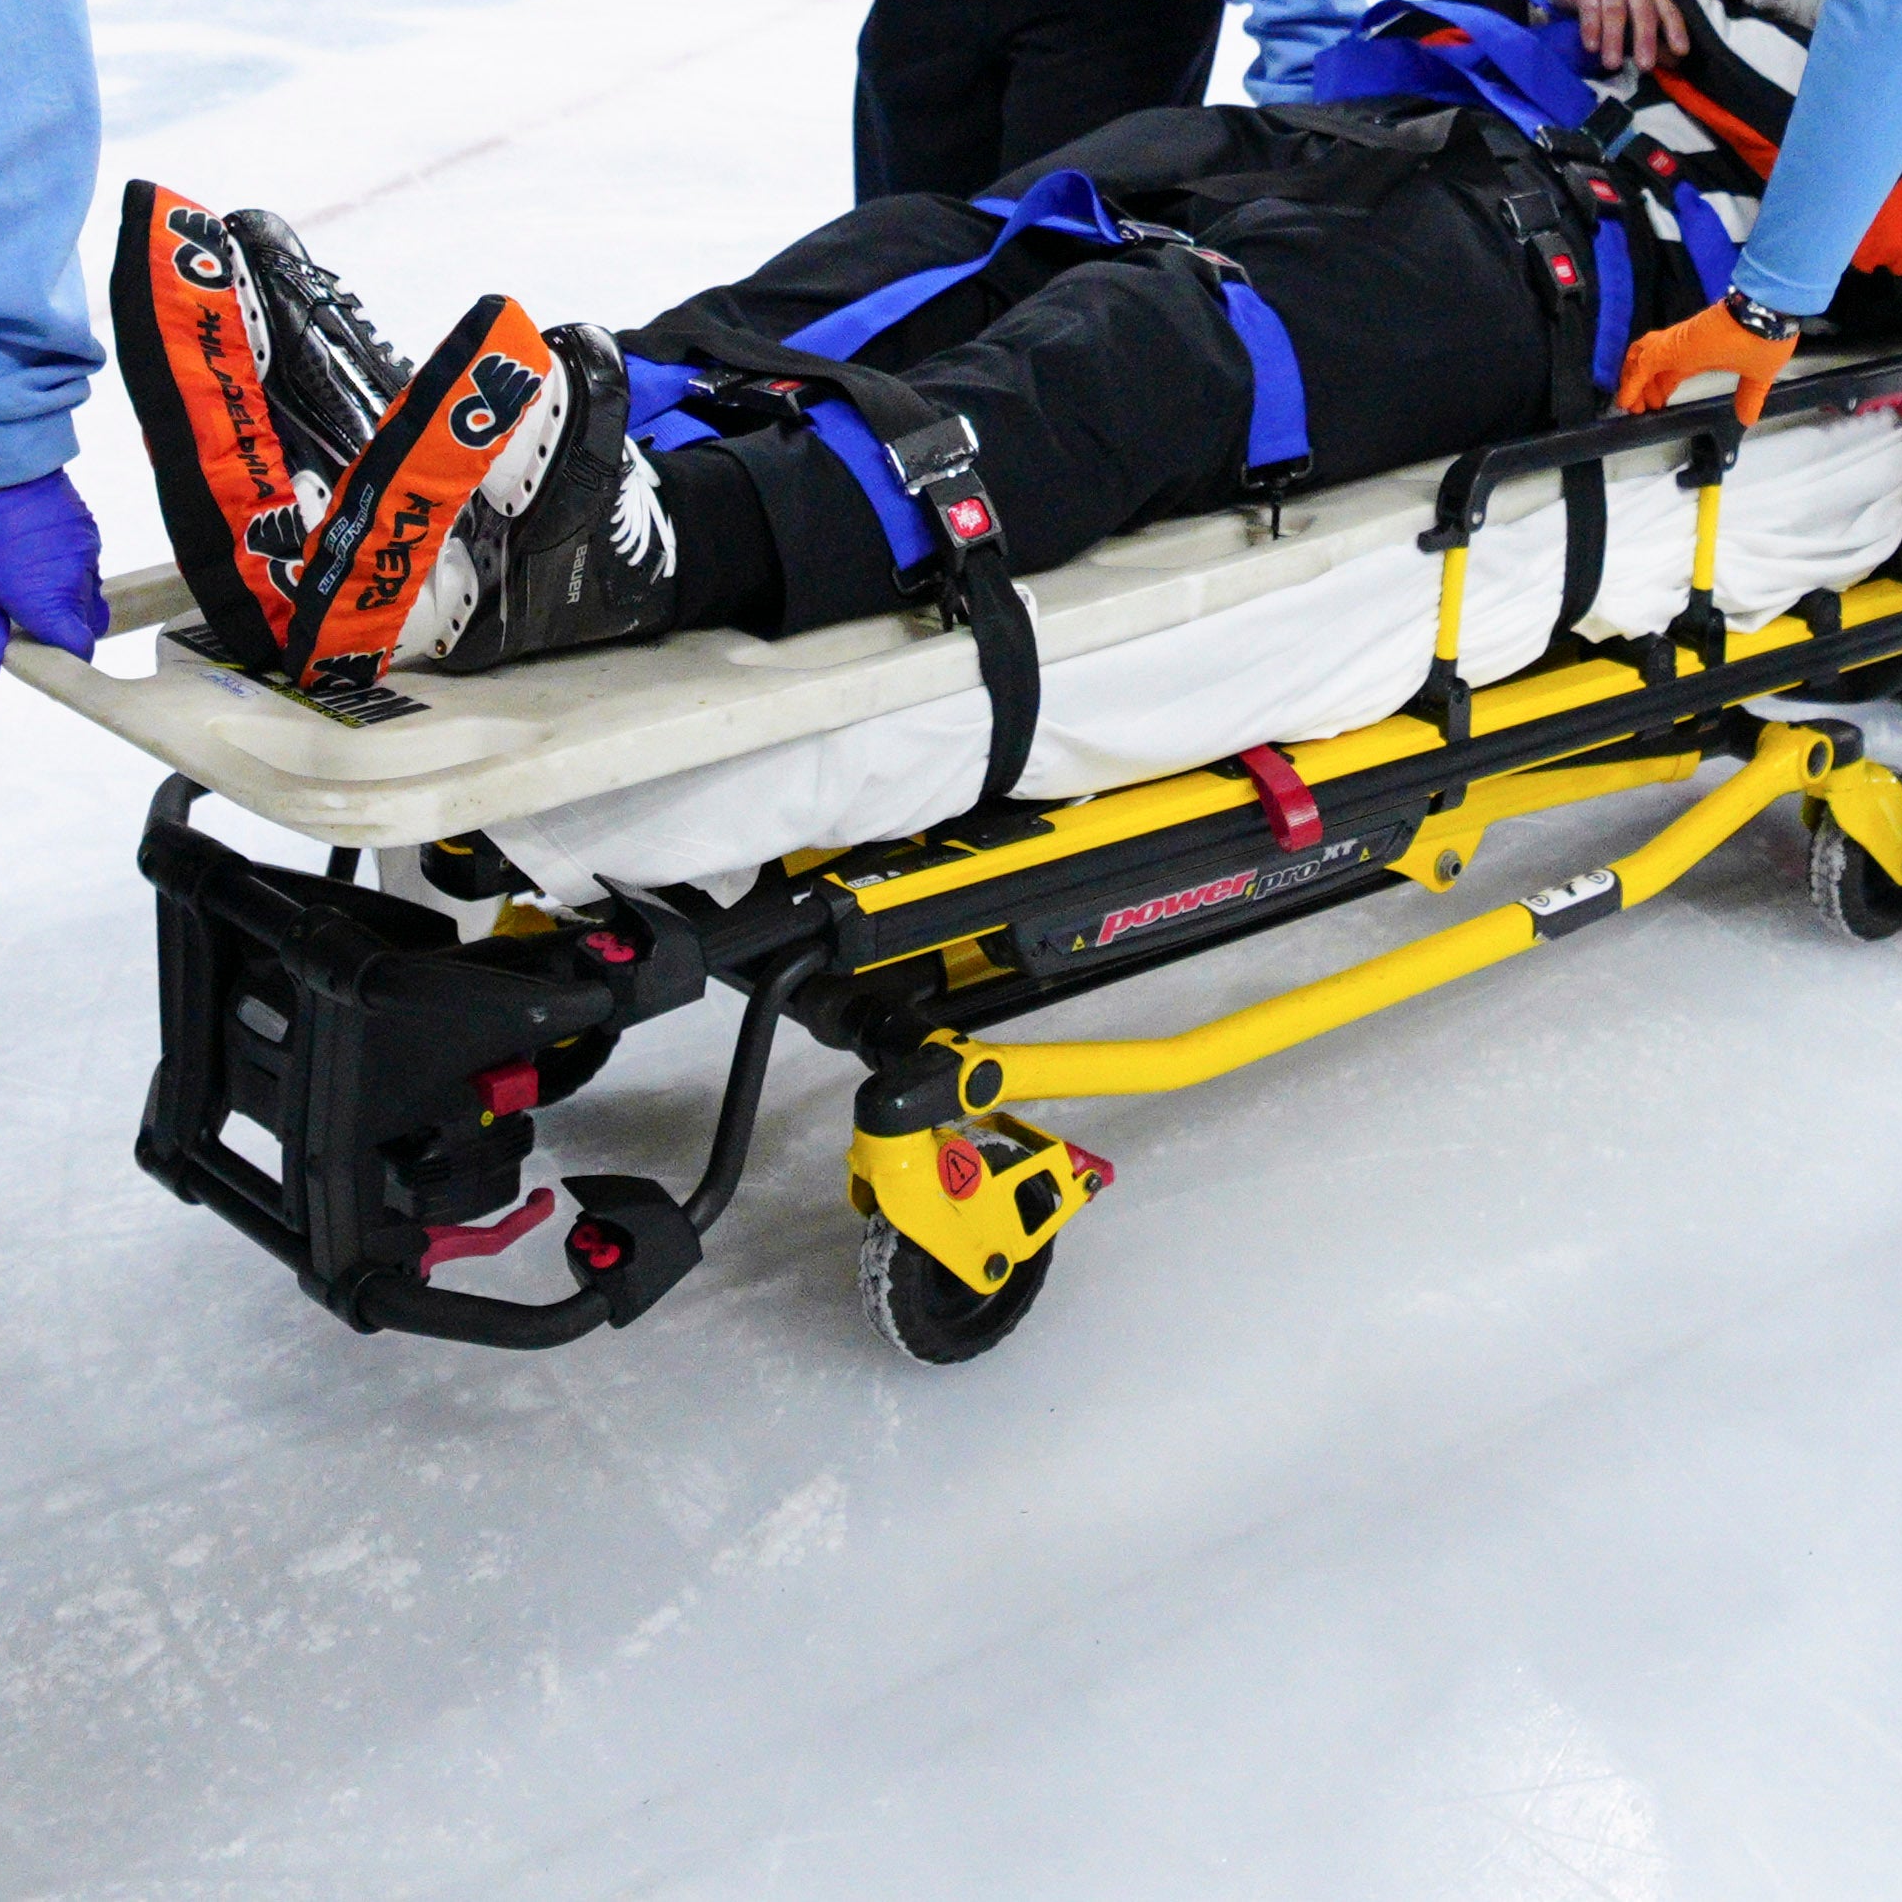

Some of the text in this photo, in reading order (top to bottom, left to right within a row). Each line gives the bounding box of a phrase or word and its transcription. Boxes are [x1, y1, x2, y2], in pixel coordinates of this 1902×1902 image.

[194, 302, 275, 500] PHILADELPHIA
[354, 491, 443, 612] FLYERS
[1095, 838, 1358, 947] power pro XT
